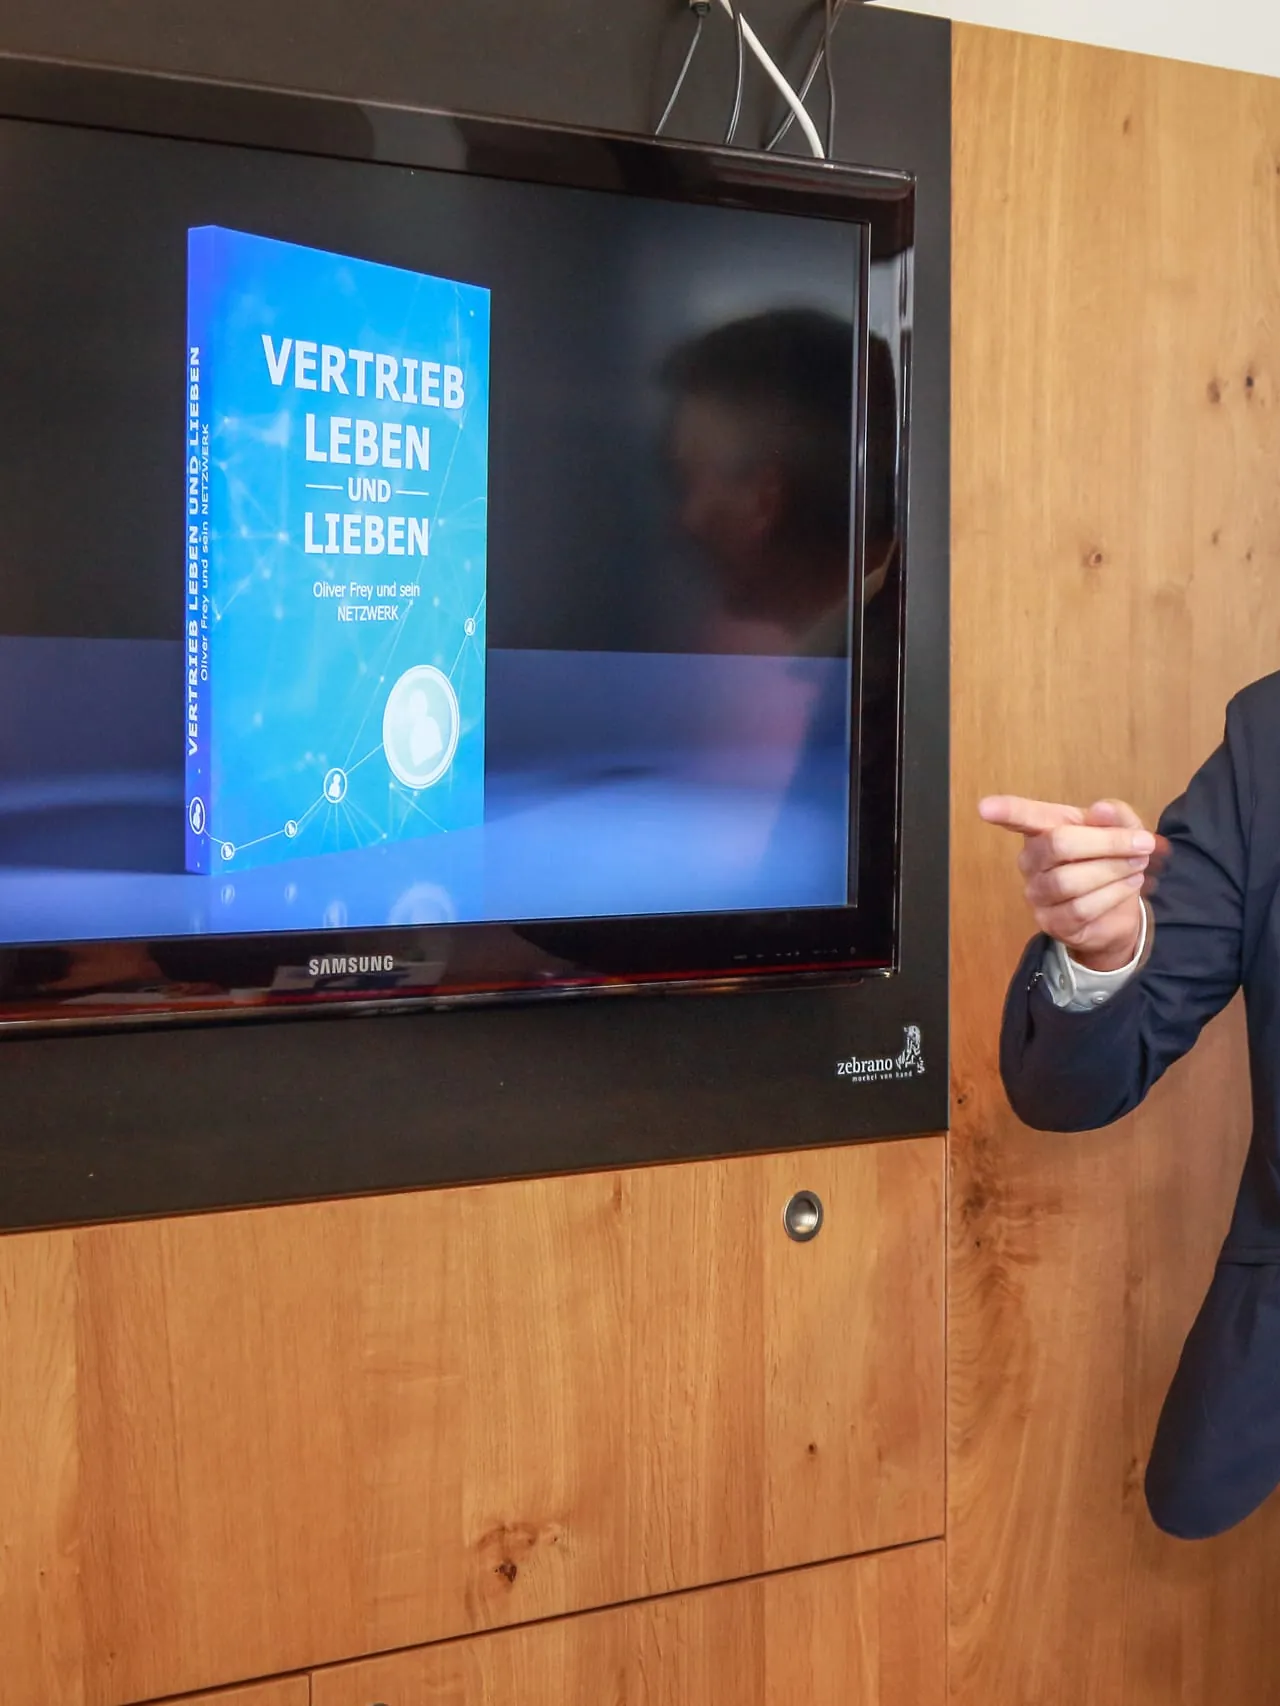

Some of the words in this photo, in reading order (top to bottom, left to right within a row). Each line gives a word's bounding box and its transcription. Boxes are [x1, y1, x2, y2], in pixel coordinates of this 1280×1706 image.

[261, 334, 465, 410] VERTRIEB
[189, 347, 200, 446] LIEBEN
[305, 413, 430, 471] LEBEN
[189, 456, 199, 515] UND
[201, 424, 209, 515] NETZWERK
[348, 477, 391, 503] UND
[304, 512, 429, 556] LIEBEN
[188, 525, 199, 611] LEBEN
[313, 582, 346, 598] Oliver
[350, 582, 373, 601] Frey
[376, 581, 397, 598] und
[399, 583, 420, 598] sein
[201, 596, 210, 629] Frey
[337, 605, 399, 622] NETZWERK
[201, 635, 209, 681] Oliver
[188, 619, 199, 756] VERTRIEB
[308, 955, 394, 976] SAMSUNG
[837, 1056, 893, 1075] zebrano
